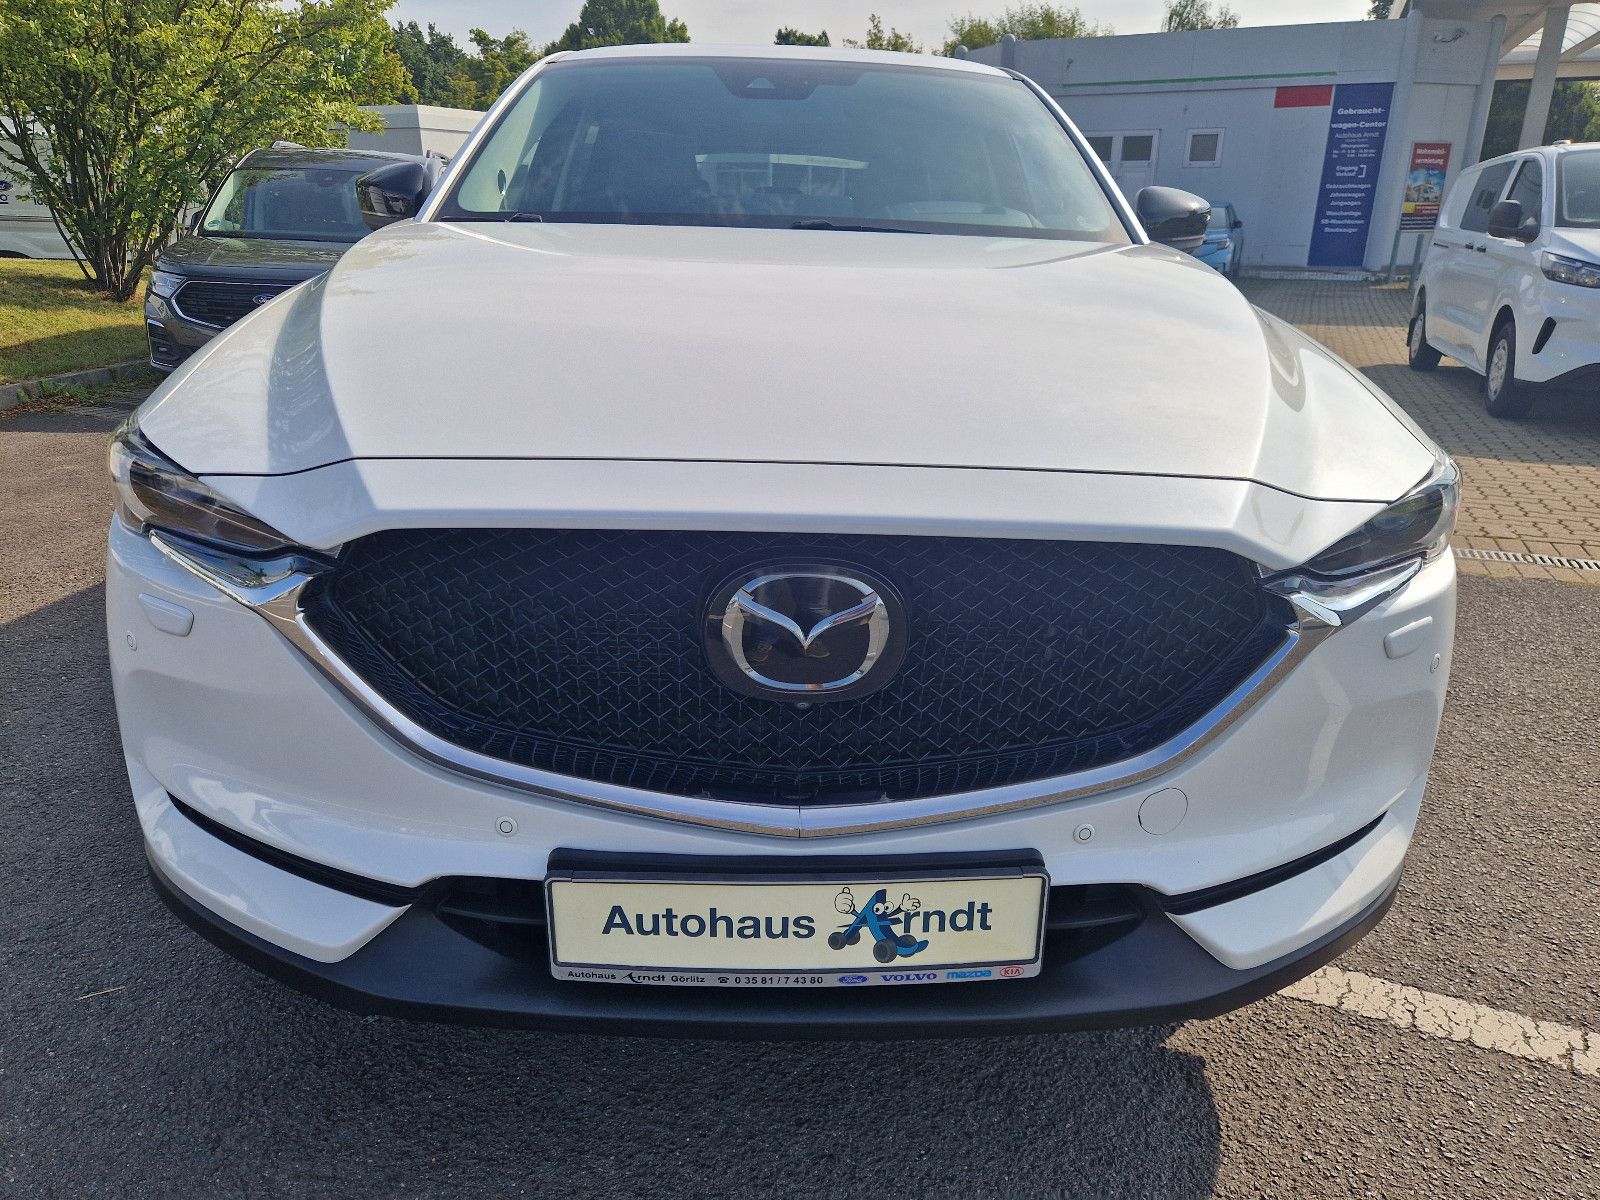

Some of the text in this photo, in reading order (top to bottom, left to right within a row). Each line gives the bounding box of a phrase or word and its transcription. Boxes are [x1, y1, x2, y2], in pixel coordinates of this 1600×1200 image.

[1337, 107, 1386, 115] Gebraucht-
[1331, 121, 1387, 129] wagen-Center
[601, 888, 993, 963] Autohaus Arndt
[946, 969, 992, 980] mazda
[1002, 967, 1022, 976] KIA
[567, 970, 617, 980] Autohaus
[621, 972, 666, 983] Arndt
[671, 975, 705, 983] Görlitz
[734, 976, 741, 984] 0
[744, 976, 758, 984] 35
[761, 976, 773, 984] 81
[784, 976, 790, 984] 7
[793, 976, 807, 984] 43
[809, 976, 823, 984] 80
[840, 975, 867, 983] Ford
[880, 973, 938, 982] VOLVO
